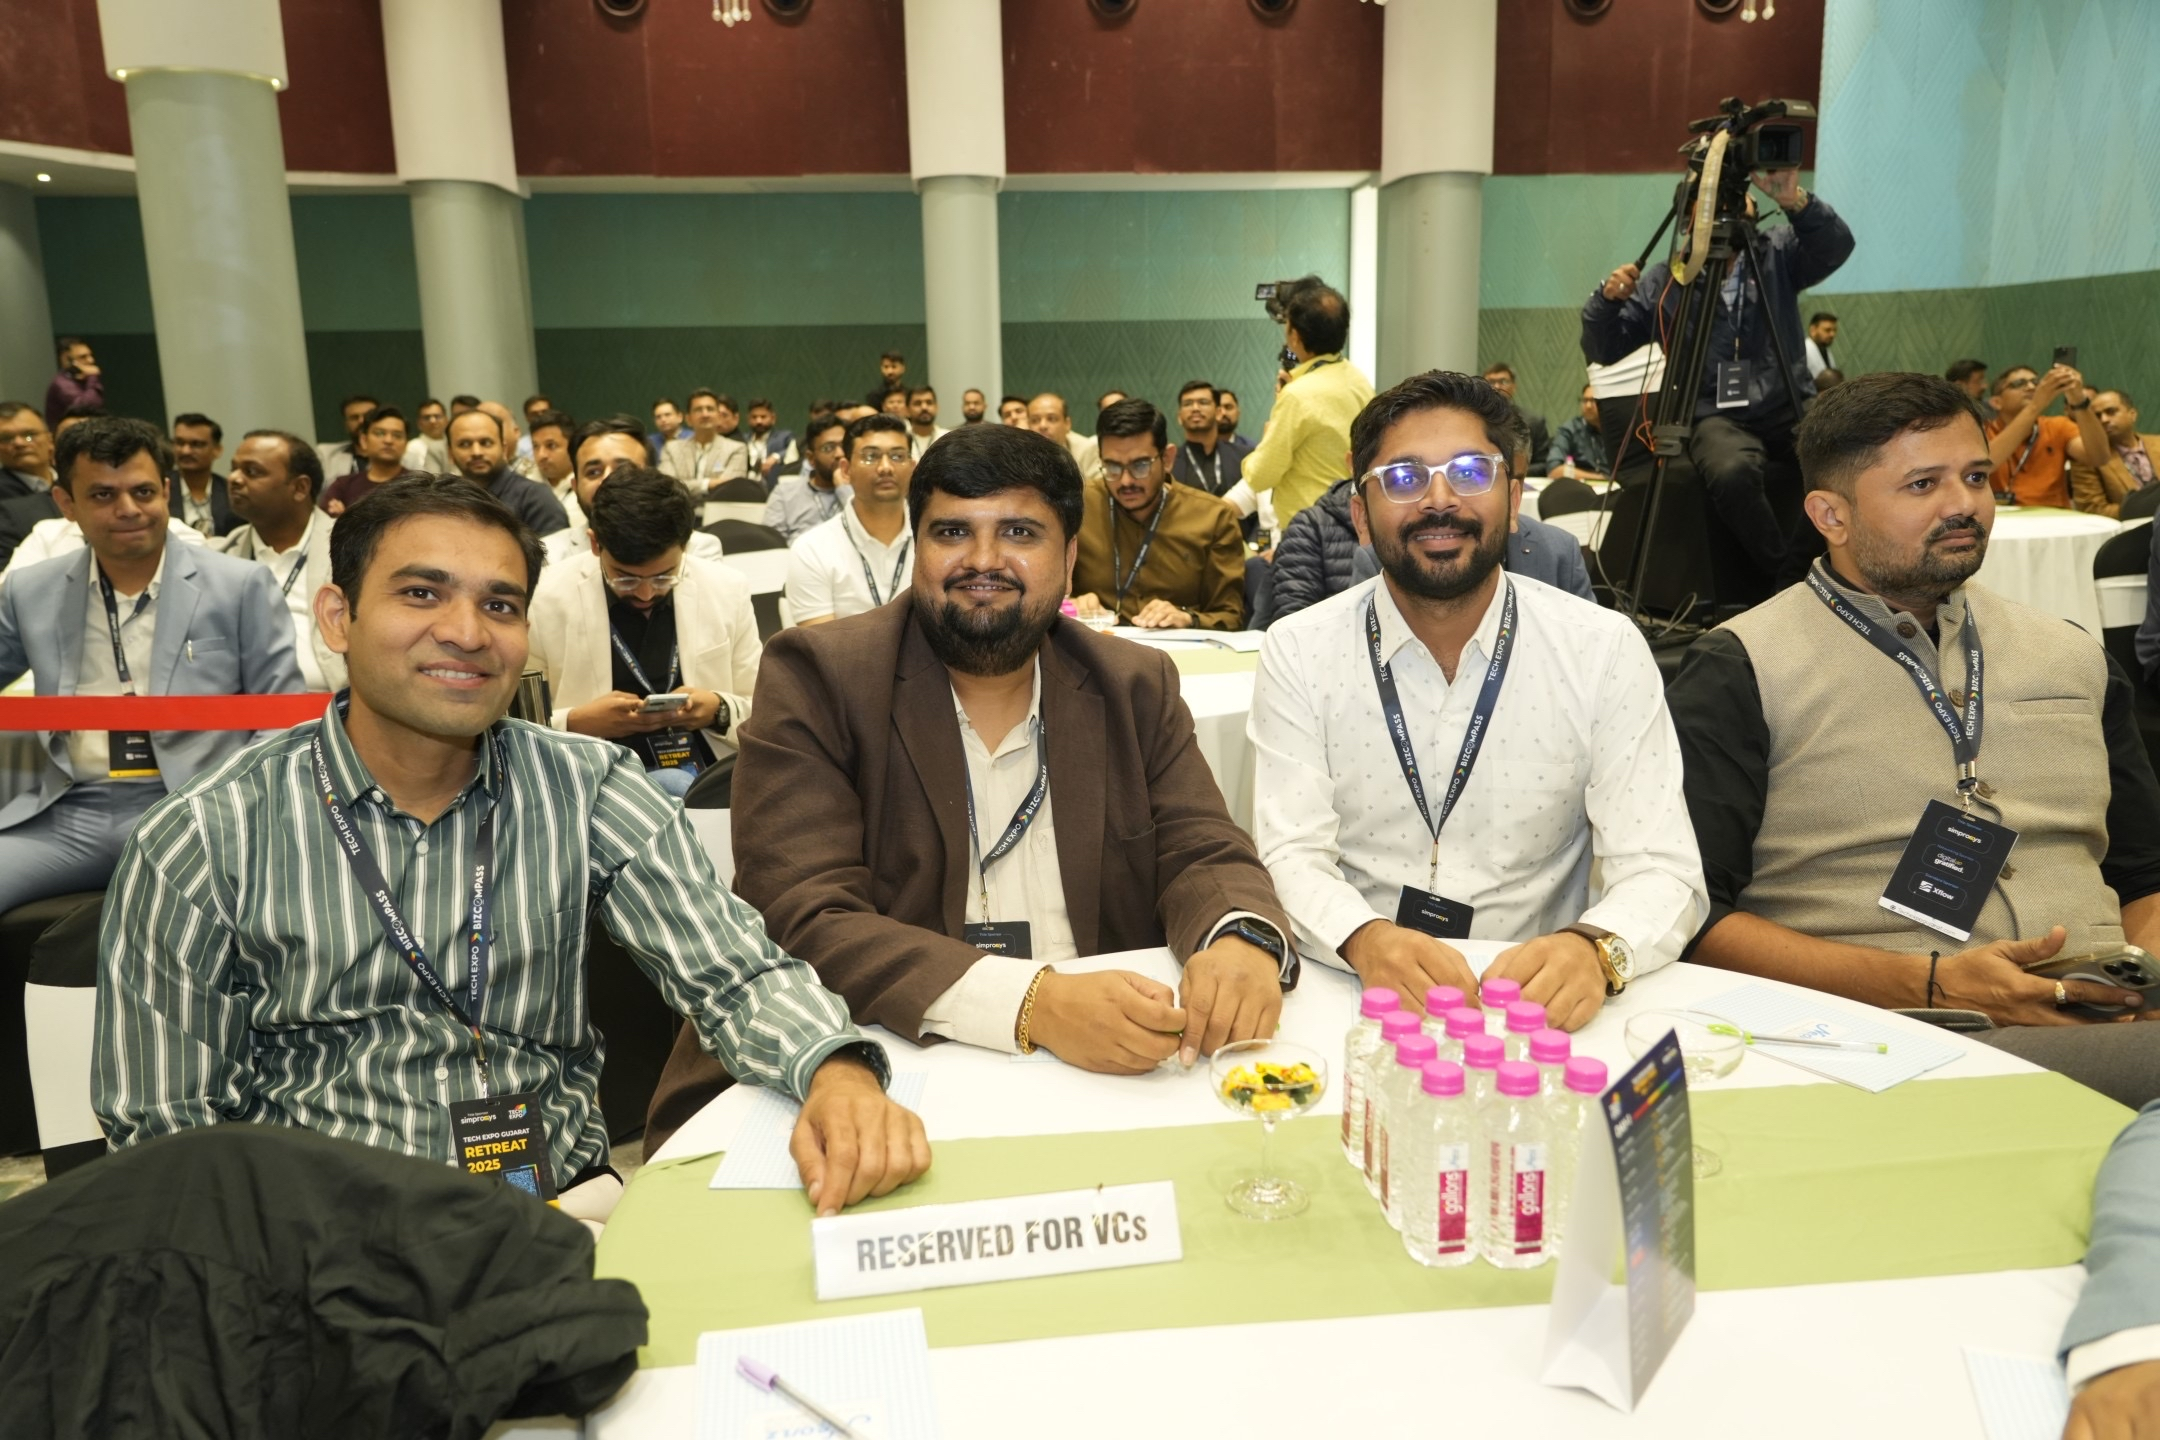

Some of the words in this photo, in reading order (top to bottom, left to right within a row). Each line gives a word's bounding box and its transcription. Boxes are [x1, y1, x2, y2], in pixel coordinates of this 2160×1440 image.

[1836, 605, 1854, 621] EXPO
[1852, 619, 1872, 636] TECH
[1488, 660, 1500, 681] TECH
[1495, 639, 1505, 660] EXPO
[1896, 651, 1935, 692] BIZCOMPASS
[1970, 650, 1979, 692] BIZCOMPASS
[1934, 701, 1952, 723] EXPO
[1968, 700, 1977, 720] EXPO
[1393, 713, 1413, 766] BIZCOMPASS
[1947, 720, 1962, 745] TECH
[313, 736, 333, 793] BIZCOMPASS
[1448, 778, 1460, 798] EXPO
[1460, 714, 1484, 767] BIZCOMPASS
[331, 805, 348, 831] EXPO
[991, 841, 1009, 857] TECH
[1005, 823, 1022, 843] EXPO
[1025, 765, 1047, 815] BIZCOMPASS
[343, 829, 361, 856] TECH
[472, 865, 485, 930] BIZCOMPASS
[375, 889, 414, 951] BIZCOMPASS
[471, 946, 480, 973] EXPO
[417, 962, 437, 986] EXPO
[471, 974, 479, 1001] TECH
[463, 1135, 481, 1143] TECH
[482, 1132, 500, 1141] EXPO
[501, 1128, 530, 1138] GUJARAT
[464, 1138, 528, 1158] RETREAT
[467, 1159, 501, 1174] 2025
[856, 1223, 1014, 1272] RESERVED
[1025, 1216, 1084, 1253] FOR
[1091, 1210, 1148, 1245] VCs
